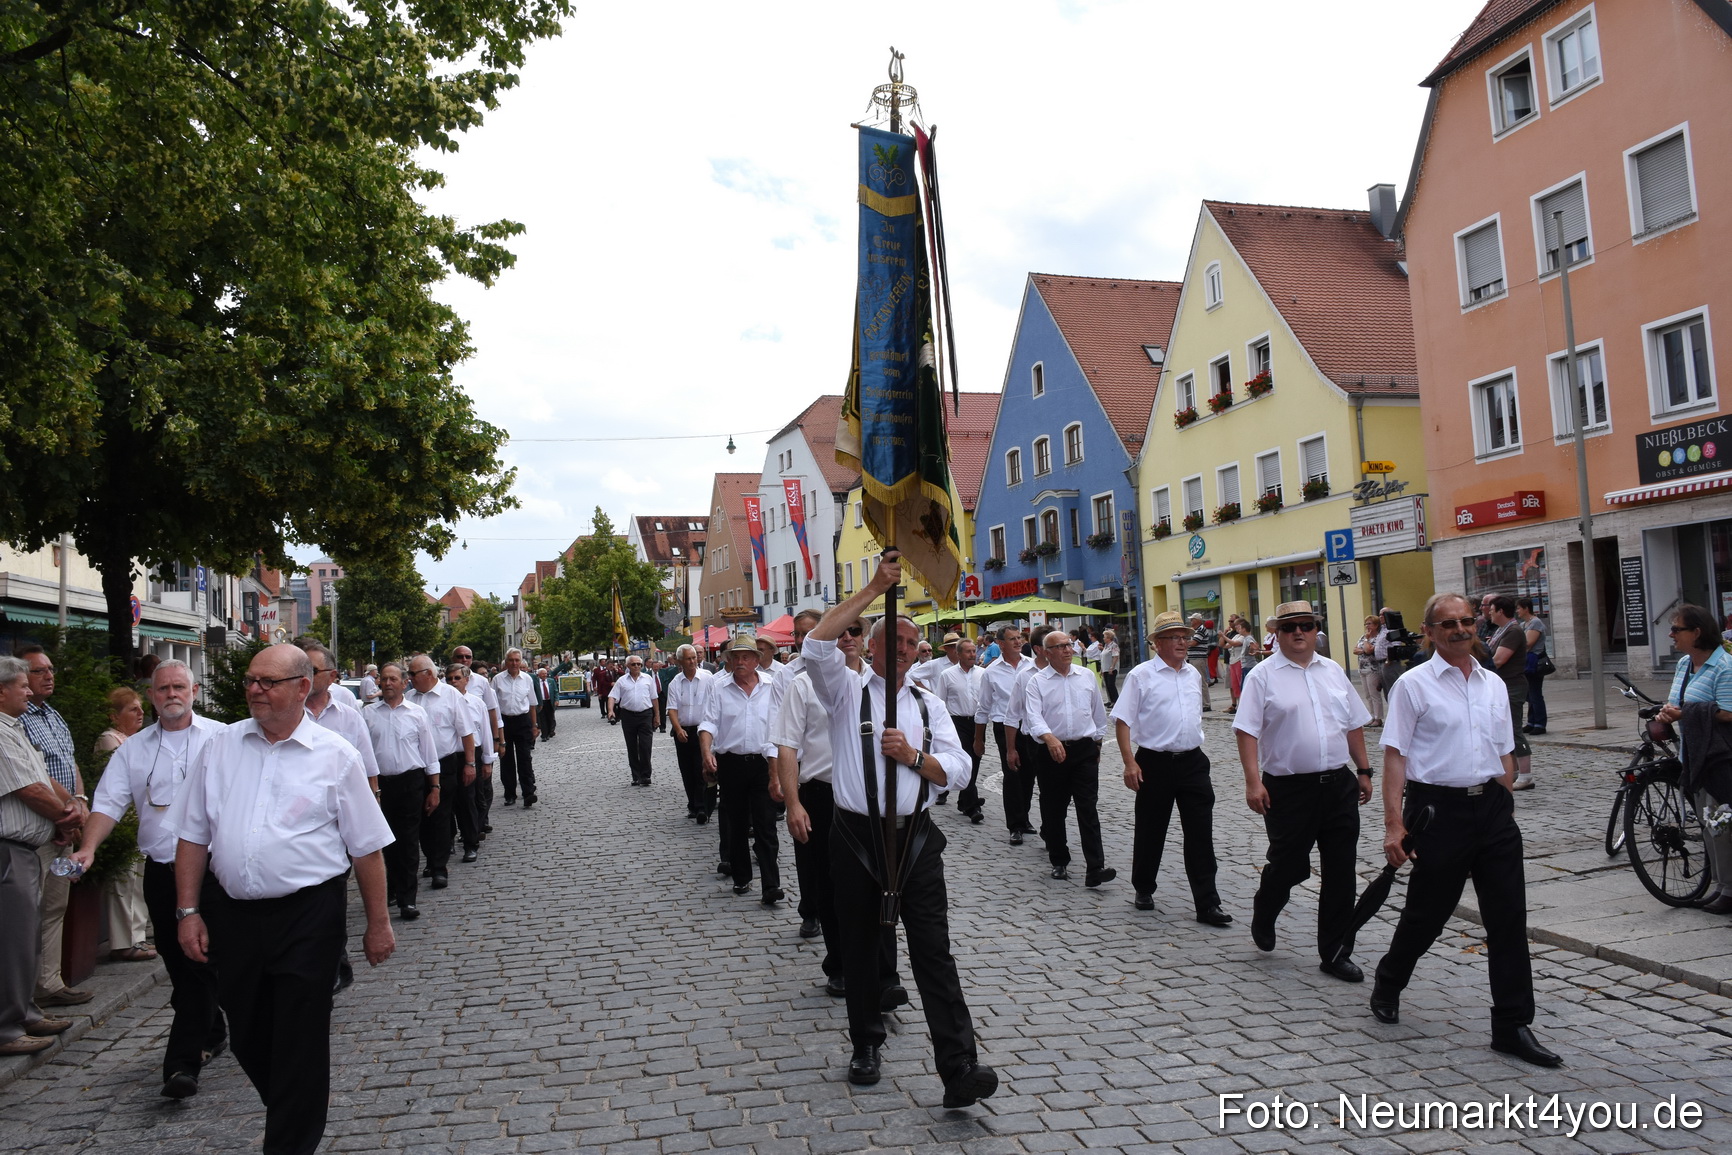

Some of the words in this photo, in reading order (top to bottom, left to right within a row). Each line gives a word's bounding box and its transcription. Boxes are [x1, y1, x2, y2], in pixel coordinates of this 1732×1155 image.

[880, 220, 895, 234] In
[873, 235, 901, 251] Treue
[864, 271, 913, 341] PATENVEREIN
[1368, 462, 1383, 471] KINO
[1655, 468, 1677, 479] OBST
[1678, 467, 1684, 475] &
[1687, 460, 1722, 473] GEMÜSE
[787, 482, 797, 507] K&L
[1522, 497, 1541, 508] DER
[1496, 501, 1516, 510] Deutsch
[1415, 497, 1425, 547] KINO
[1457, 511, 1474, 526] DER
[1497, 510, 1517, 519] Reisebü
[1361, 523, 1385, 537] RIALTO
[1387, 519, 1404, 533] KINO
[863, 539, 879, 553] HOTEL
[1331, 533, 1347, 559] P
[199, 569, 204, 588] P
[960, 574, 965, 591] P
[991, 578, 1038, 600] APOTHEKE
